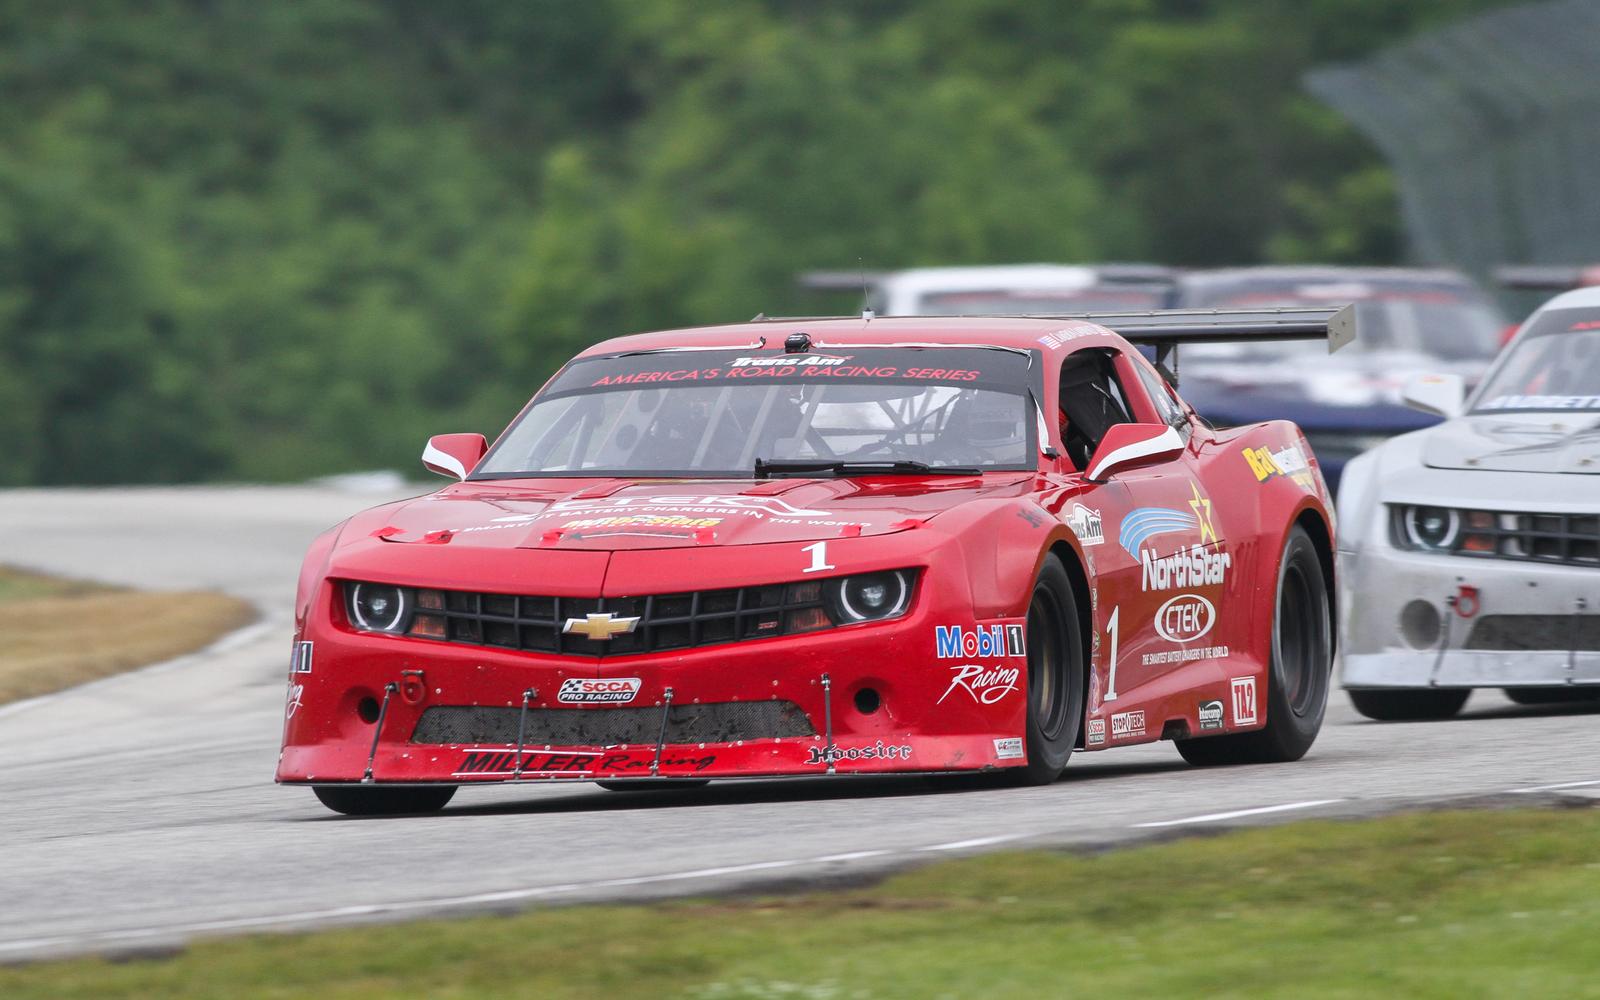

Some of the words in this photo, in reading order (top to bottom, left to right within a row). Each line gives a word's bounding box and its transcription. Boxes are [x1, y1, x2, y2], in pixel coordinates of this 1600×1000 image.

[591, 367, 722, 387] AMERICA'S
[726, 365, 797, 378] ROAD
[800, 366, 897, 377] RACING
[902, 367, 981, 381] SERIES
[559, 506, 642, 518] BATTERY
[642, 506, 738, 514] CHARGERS
[743, 510, 764, 519] IN
[768, 517, 802, 525] THE
[800, 540, 835, 573] 1
[1141, 544, 1231, 592] NorthStar
[1165, 602, 1202, 634] CTEK
[935, 624, 1006, 659] Mobil
[1103, 605, 1119, 701] 1
[1212, 645, 1229, 658] WORLD
[582, 682, 633, 692] SCCA
[586, 693, 632, 701] RACING
[936, 664, 1020, 705] Racing
[1234, 682, 1254, 720] TA2
[458, 753, 593, 771] MILLER
[804, 740, 912, 764] Hoosier
